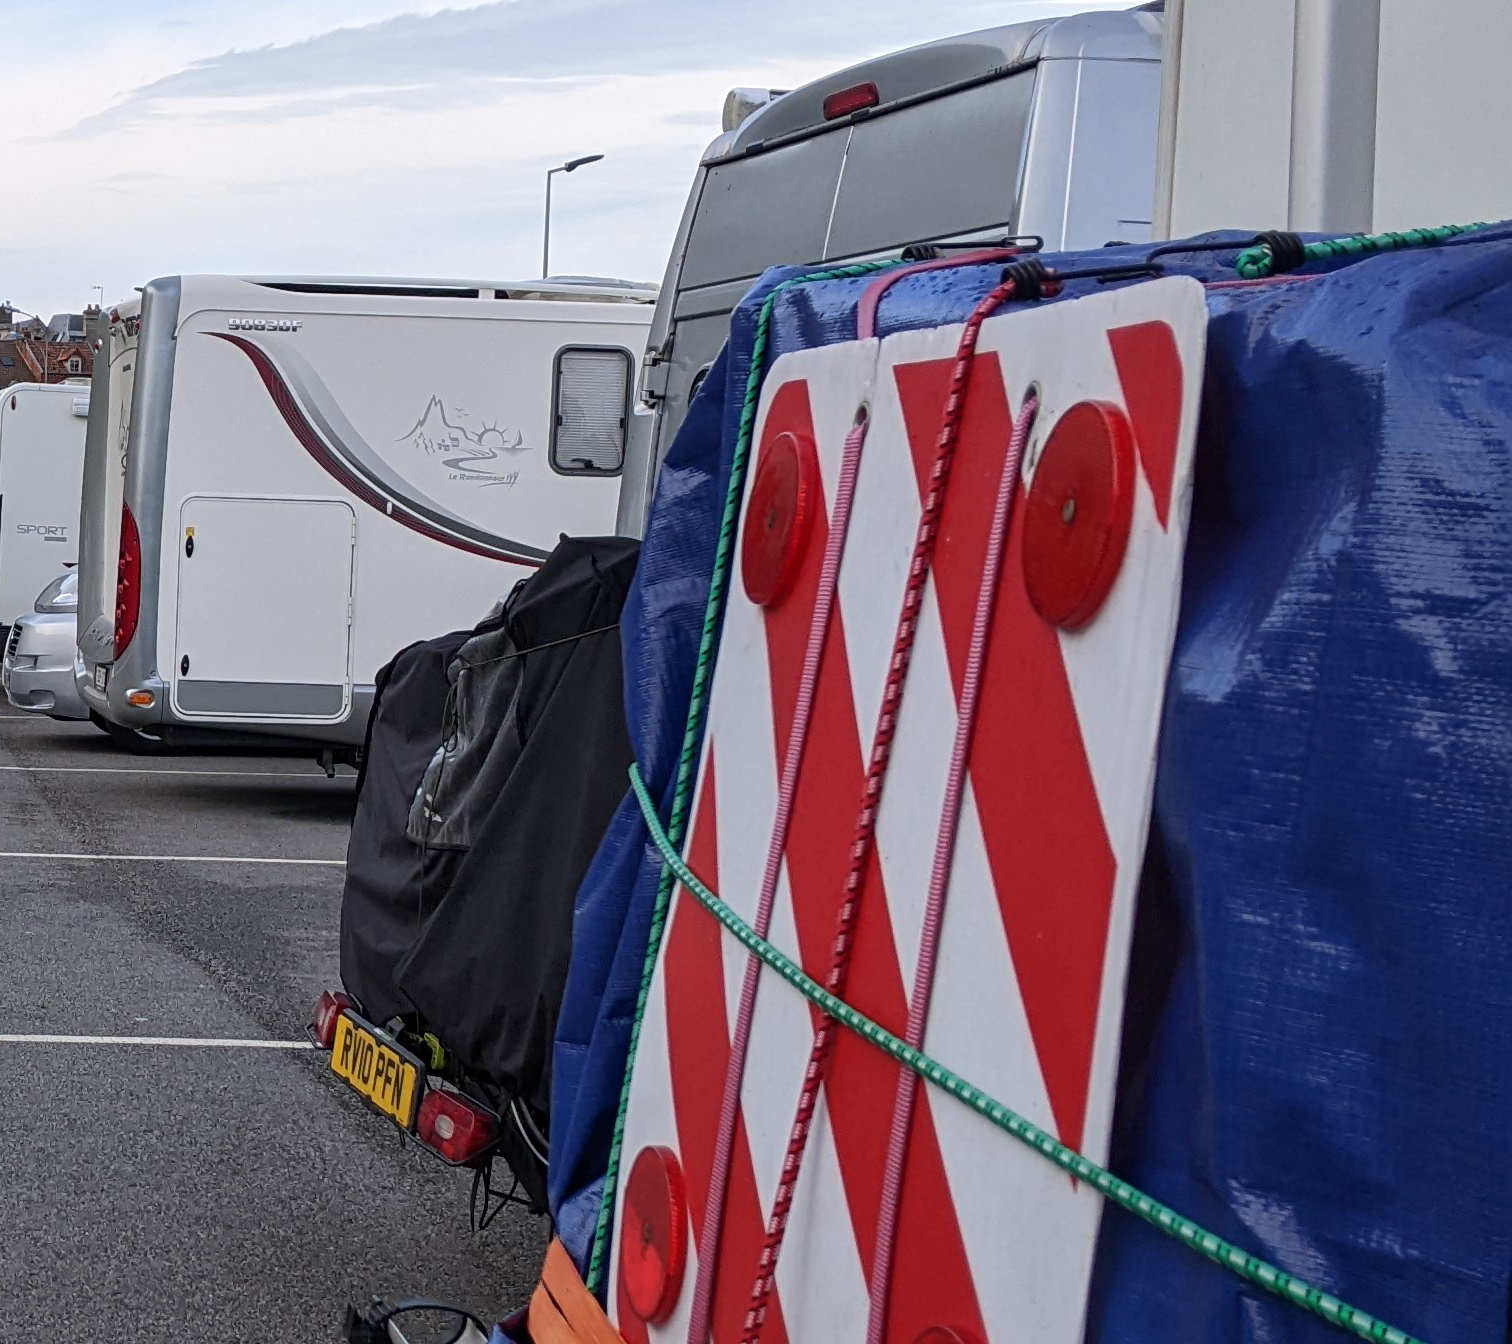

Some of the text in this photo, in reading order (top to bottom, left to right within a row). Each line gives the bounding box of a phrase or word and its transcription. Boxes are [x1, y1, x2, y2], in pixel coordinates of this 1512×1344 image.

[228, 318, 303, 332] 9083DF
[16, 524, 68, 536] SPORT
[340, 1026, 405, 1111] RV10 PFN
